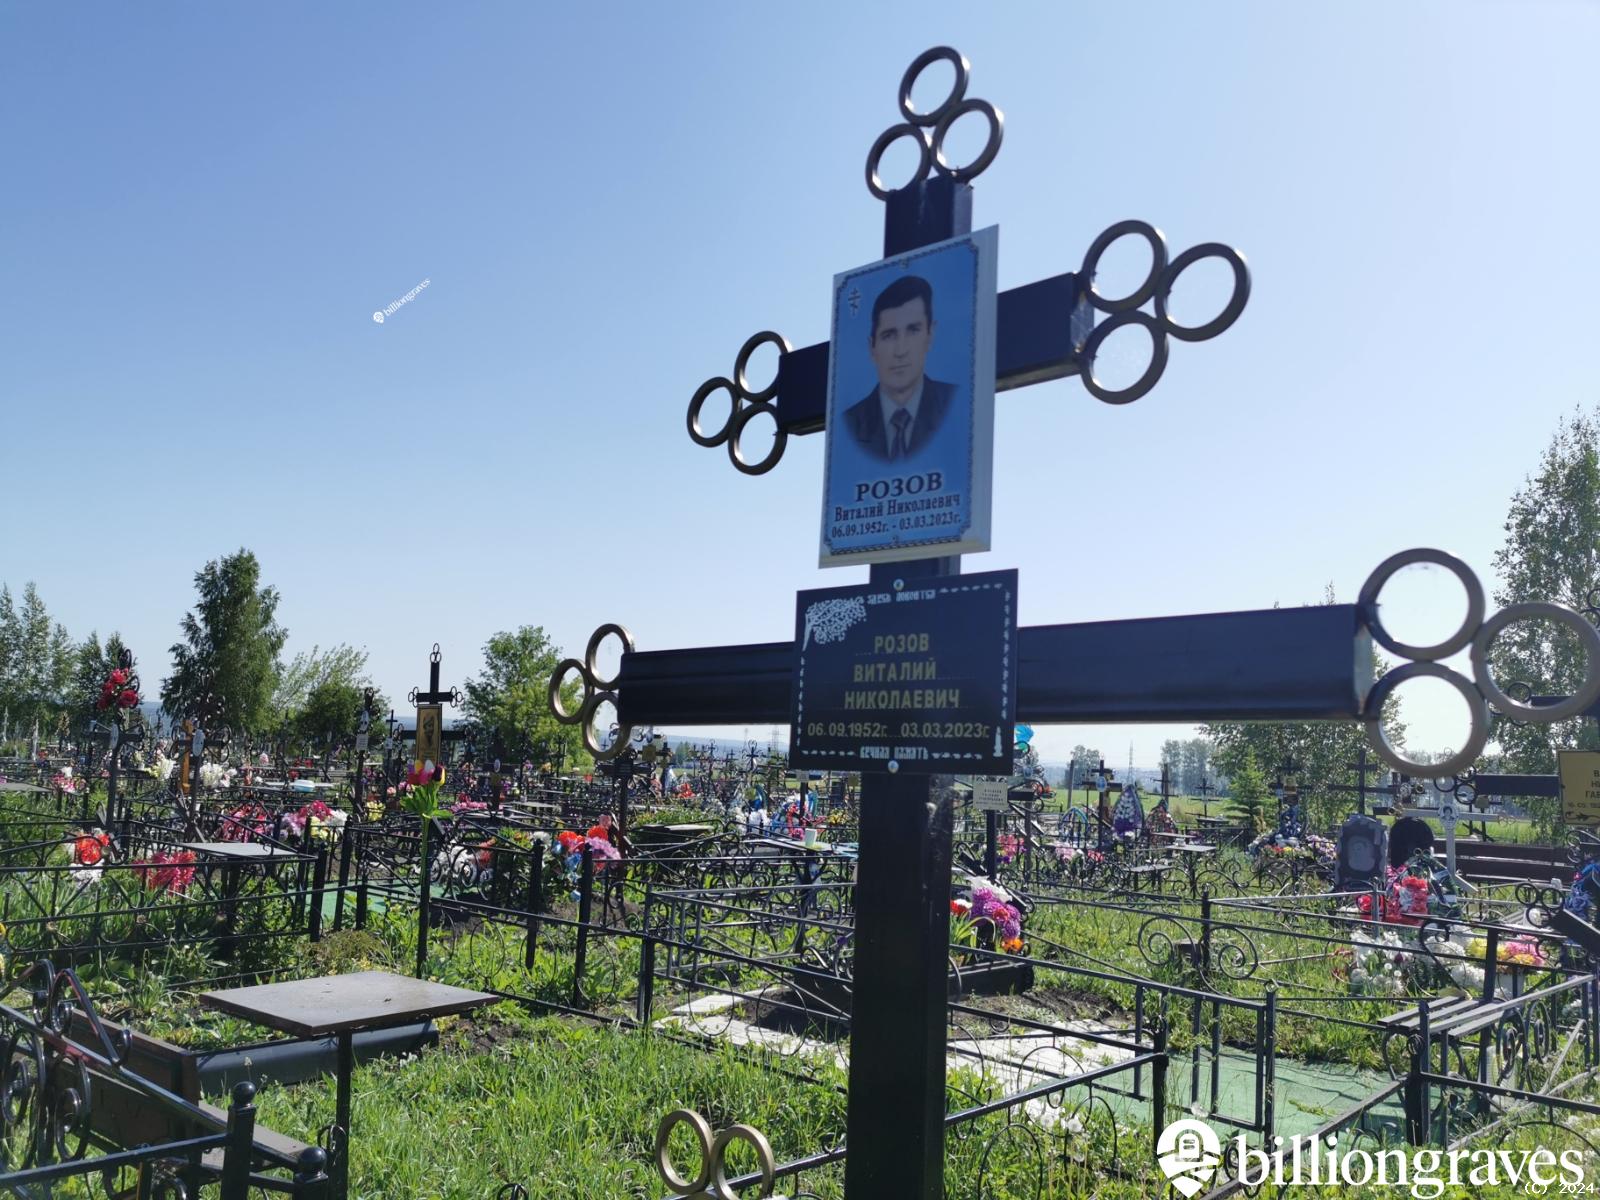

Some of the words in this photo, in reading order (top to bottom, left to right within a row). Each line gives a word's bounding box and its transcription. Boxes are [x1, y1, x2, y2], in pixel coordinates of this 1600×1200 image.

[855, 472, 942, 502] РОЗОВ
[835, 501, 884, 521] Виталий
[887, 494, 960, 515] Николаевич
[831, 521, 889, 538] 06.09.1952г.
[899, 512, 961, 530] 03.03.2023г.
[873, 632, 930, 654] РОЗОВ
[853, 657, 937, 682] ВИТАЛИЙ
[844, 689, 960, 710] НИКОЛАЕВИЧ
